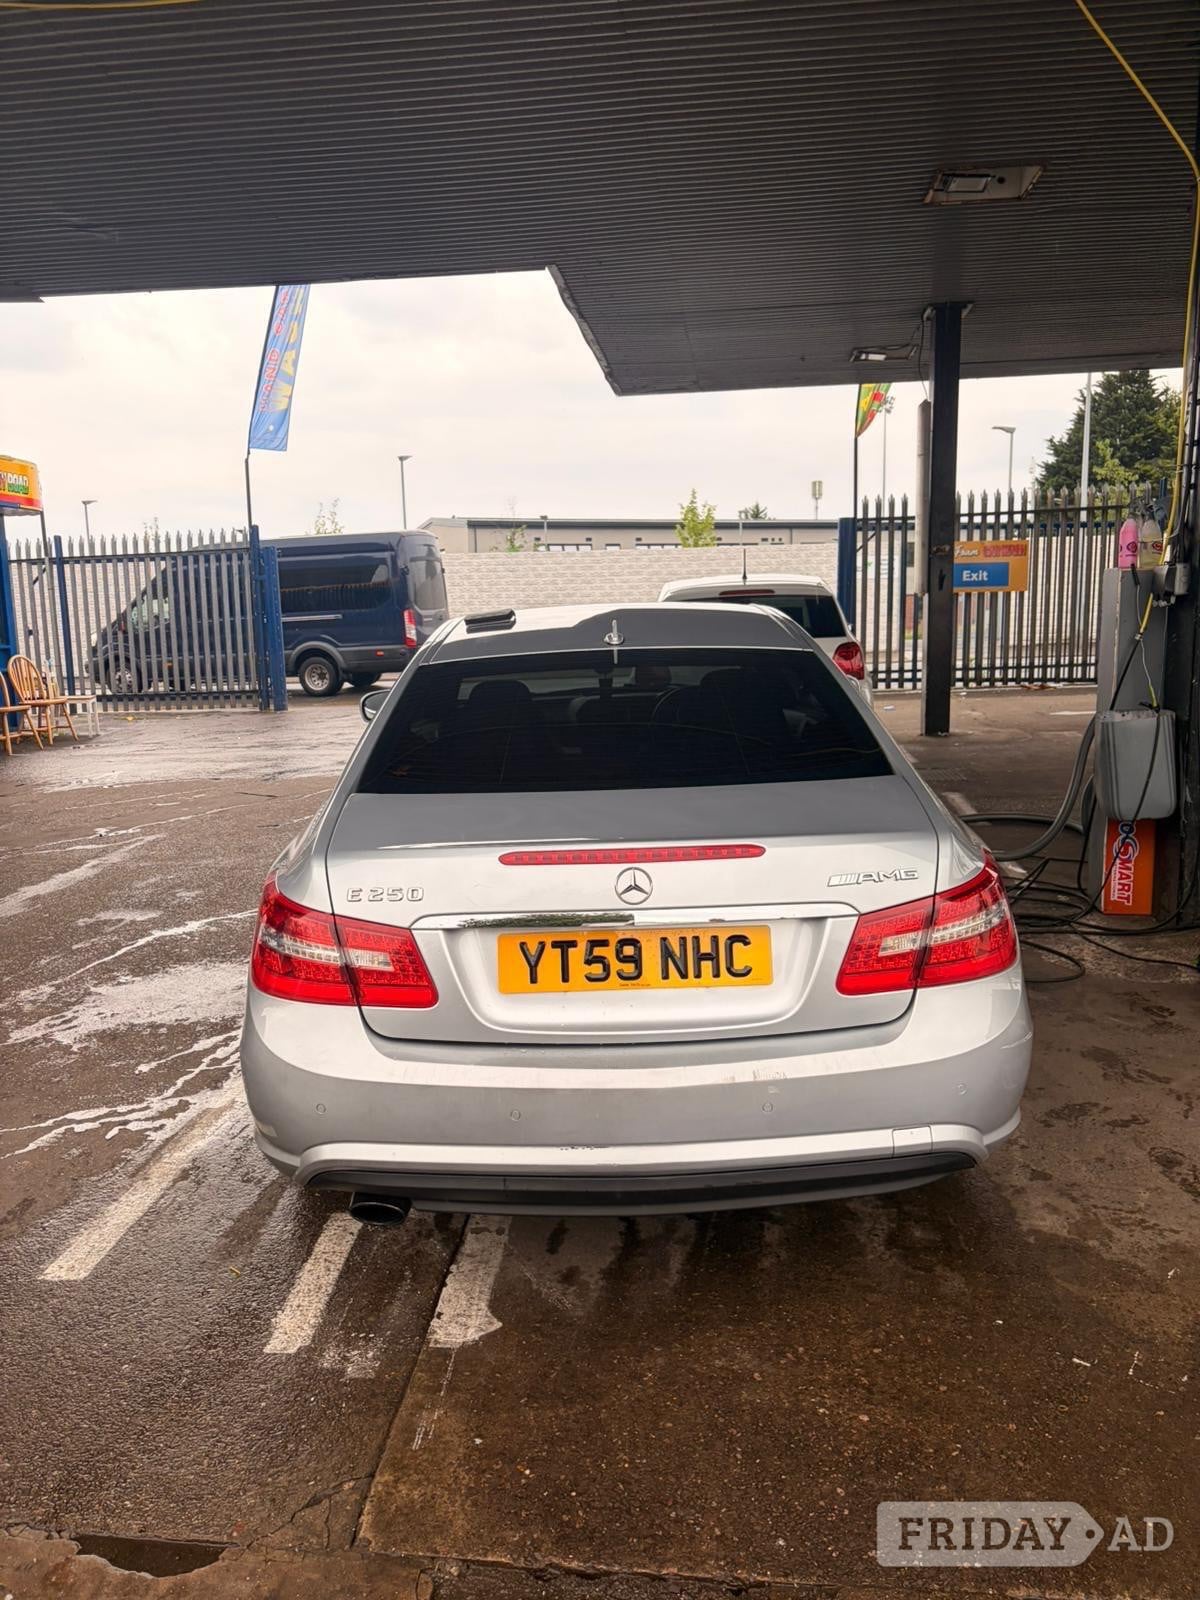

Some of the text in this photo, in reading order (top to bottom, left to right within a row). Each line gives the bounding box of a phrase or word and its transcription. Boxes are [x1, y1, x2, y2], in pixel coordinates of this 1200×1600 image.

[962, 570, 988, 582] Exit
[856, 868, 919, 885] AMG
[346, 886, 424, 903] E 250
[519, 934, 752, 984] YT59 NHC
